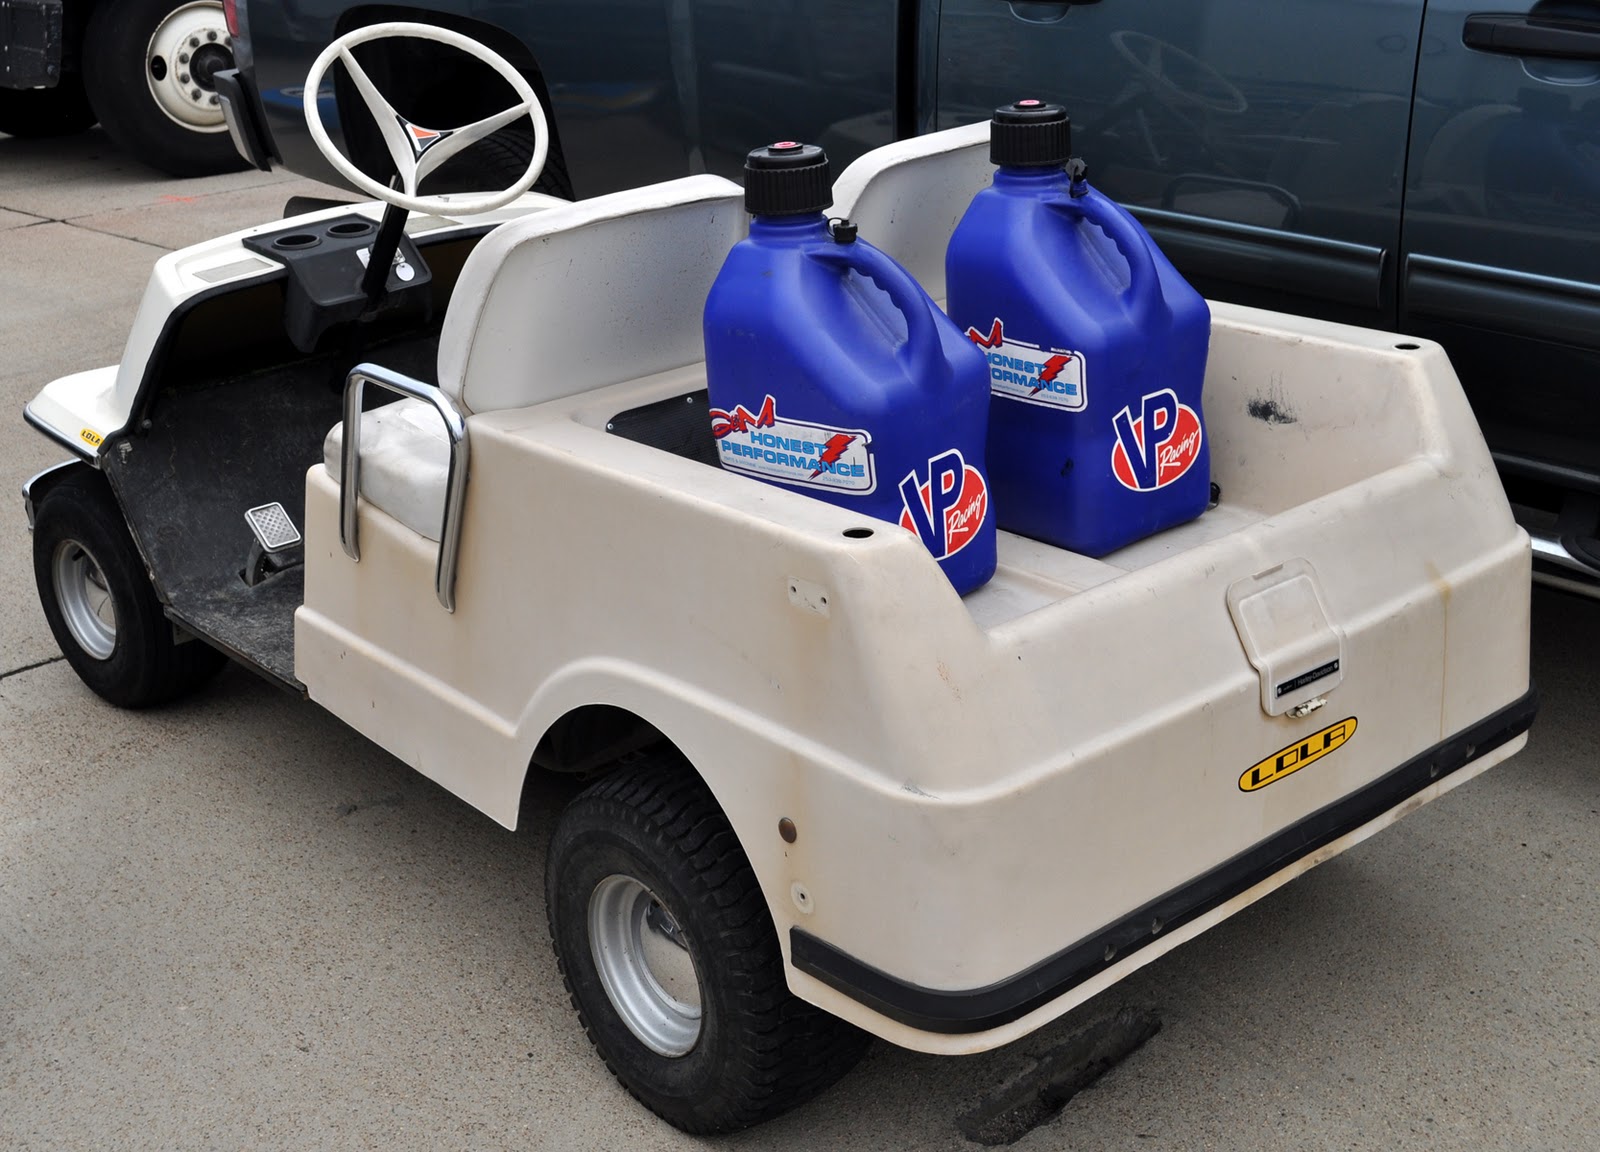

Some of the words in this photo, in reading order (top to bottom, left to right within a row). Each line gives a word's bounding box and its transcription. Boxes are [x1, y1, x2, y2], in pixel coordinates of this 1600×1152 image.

[991, 368, 1078, 396] ORMANCE
[81, 430, 101, 445] LOLA
[721, 440, 865, 478] PERFORMANCE
[750, 431, 826, 457] HONEST
[1113, 389, 1178, 488] VP
[1160, 427, 1199, 476] Racing
[900, 450, 964, 559] VP
[948, 489, 985, 544] Racing
[1251, 724, 1346, 787] LOLA
